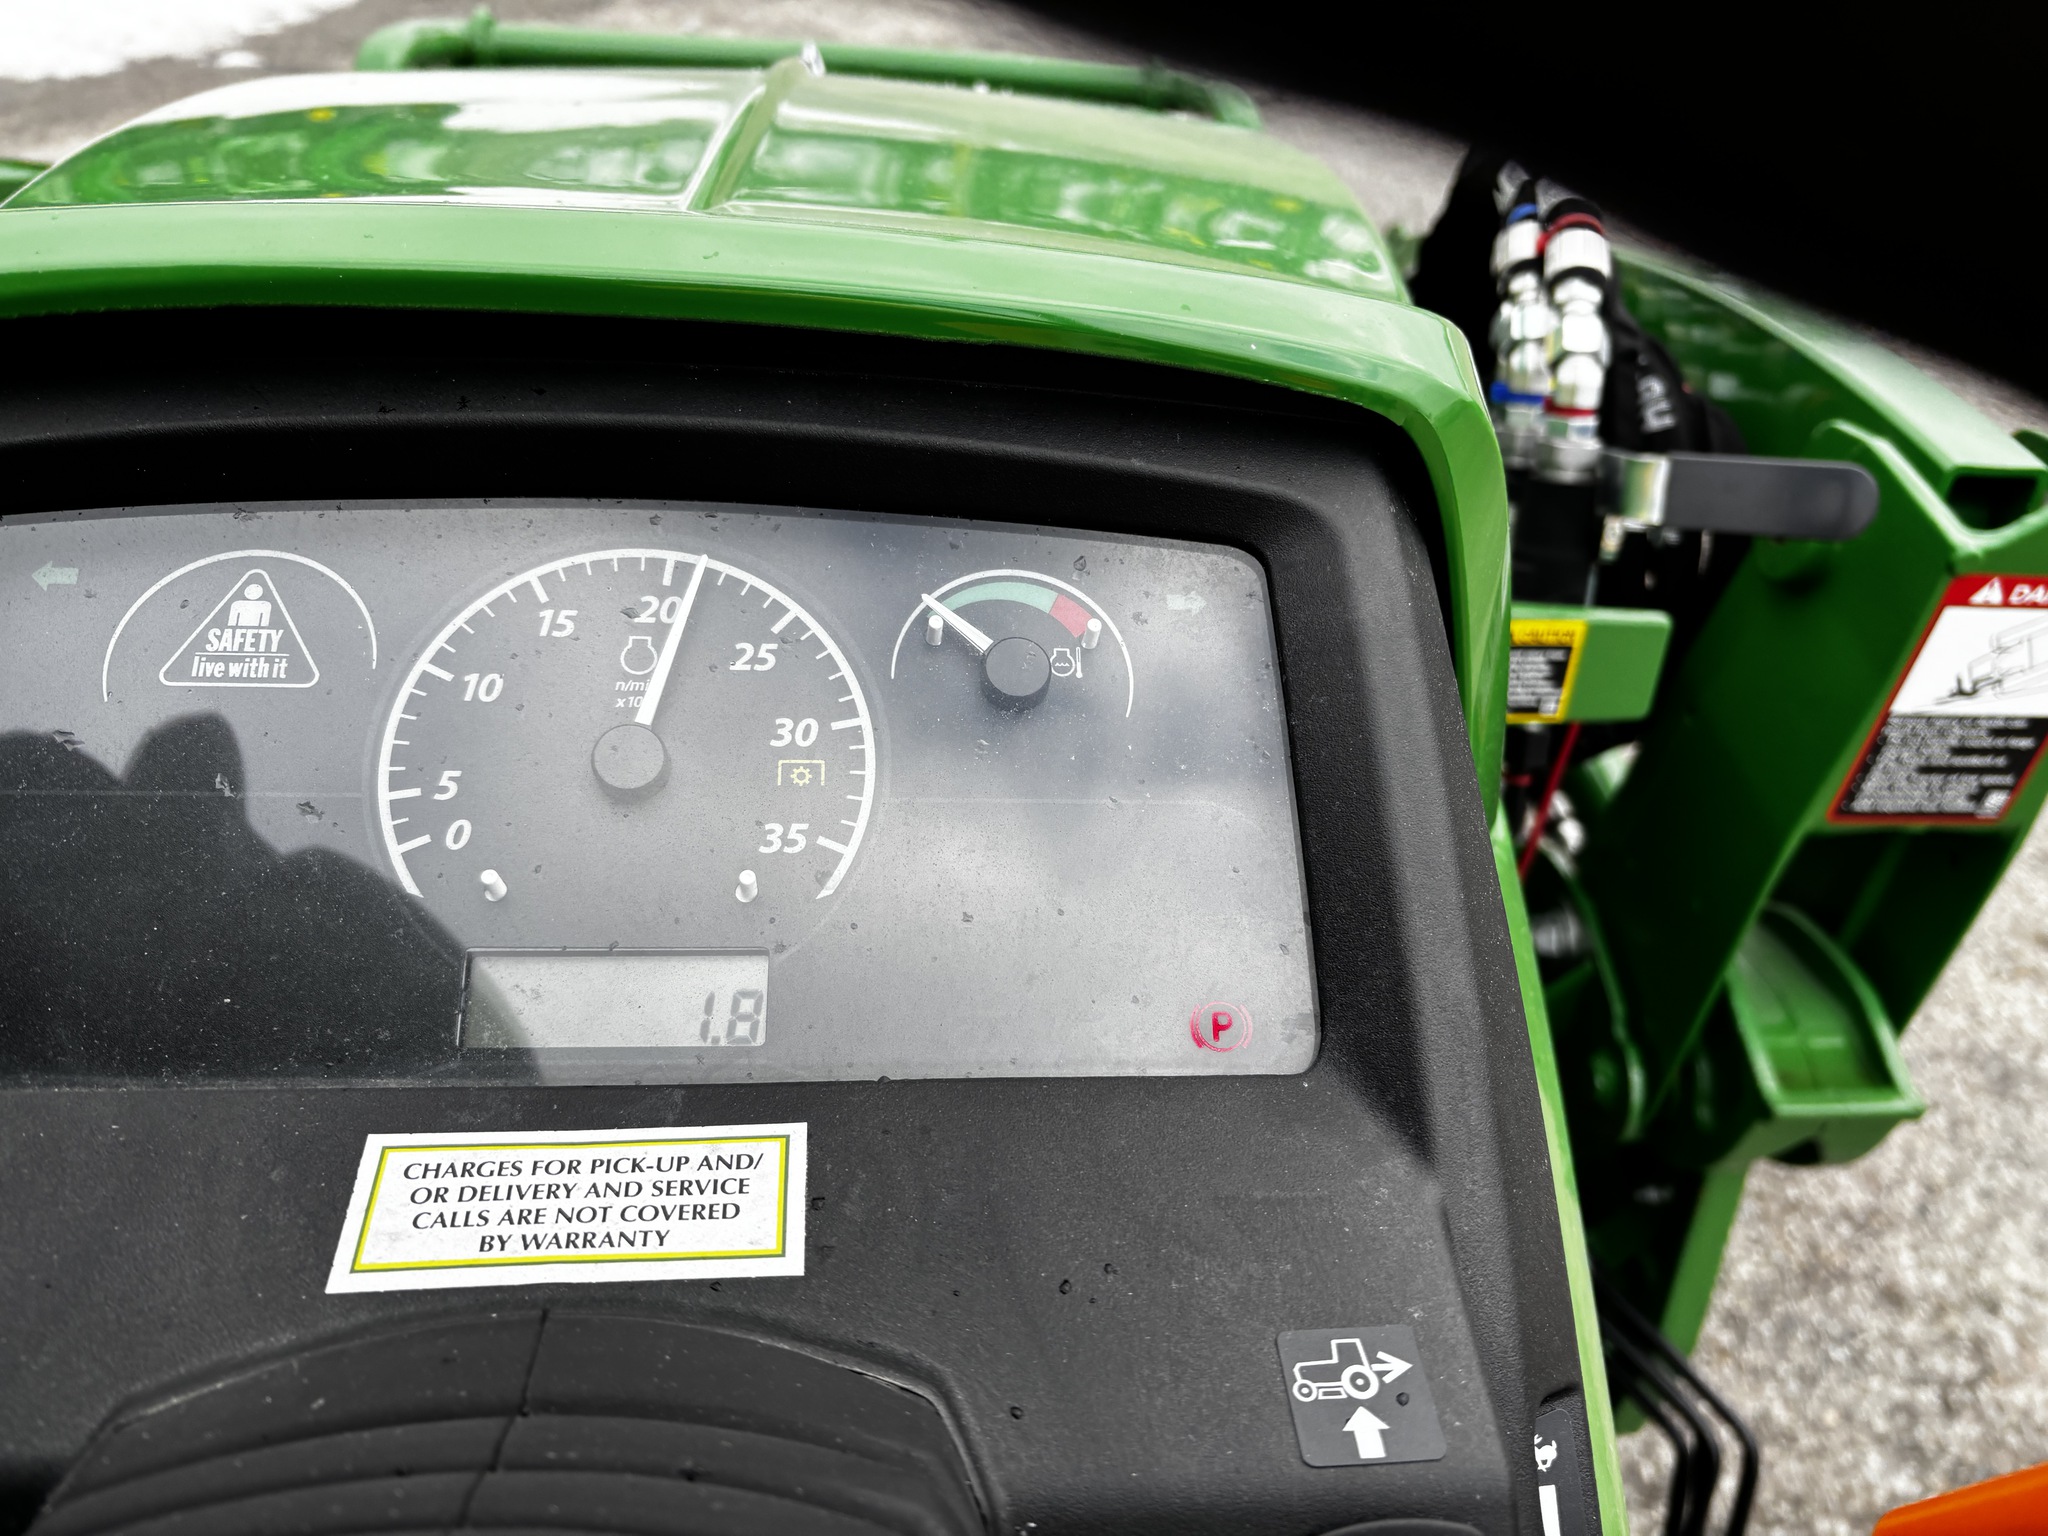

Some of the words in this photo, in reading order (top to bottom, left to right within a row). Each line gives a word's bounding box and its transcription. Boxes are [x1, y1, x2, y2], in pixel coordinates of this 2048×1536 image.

[539, 609, 578, 637] 15
[634, 595, 683, 624] 20
[205, 629, 284, 652] SAFETY
[191, 656, 225, 678] live
[229, 658, 269, 678] with
[272, 659, 288, 679] it
[730, 643, 778, 671] 25
[463, 673, 503, 702] 10
[615, 679, 650, 691] n/mi
[770, 718, 819, 747] 30
[434, 770, 462, 800] 5
[445, 819, 472, 850] 0
[759, 823, 809, 854] 35
[701, 989, 763, 1046] 1.8
[1212, 1011, 1233, 1042] P
[403, 1160, 523, 1180] CHARGES
[531, 1159, 582, 1176] FOR
[590, 1156, 690, 1174] PICK-UP
[697, 1153, 764, 1171] AND/
[410, 1186, 449, 1205] OR
[457, 1182, 578, 1203] DELIVERY
[584, 1181, 643, 1199] AND
[651, 1178, 751, 1197] SERVICE
[412, 1209, 490, 1230] CALLS
[497, 1207, 548, 1226] ARE
[555, 1206, 613, 1224] NOT
[620, 1202, 741, 1223] COVERED
[479, 1234, 513, 1253] BY
[521, 1229, 670, 1251] WARRANTY
